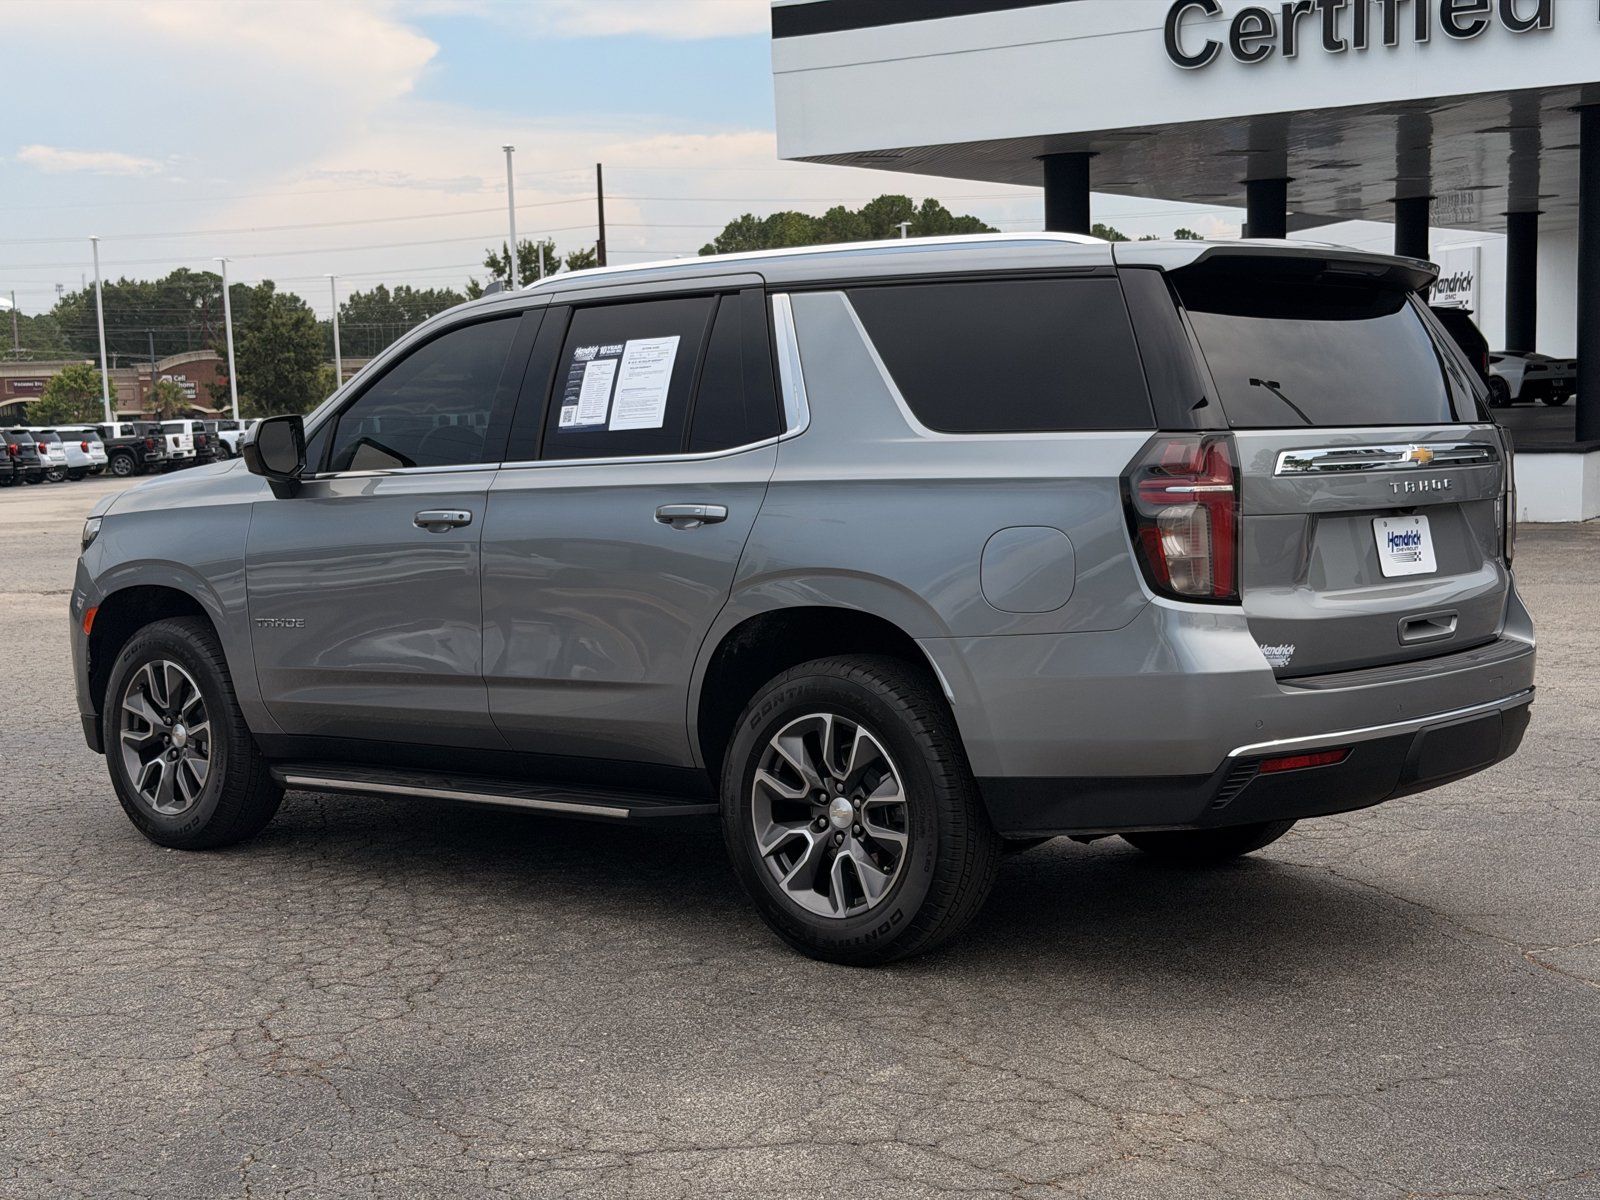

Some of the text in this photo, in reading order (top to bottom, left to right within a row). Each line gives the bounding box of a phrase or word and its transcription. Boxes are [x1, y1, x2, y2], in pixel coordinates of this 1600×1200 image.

[1390, 479, 1452, 493] TAHOE
[1387, 530, 1421, 553] Hendrick
[254, 618, 305, 628] TAHOE
[1260, 644, 1296, 655] Hendrick
